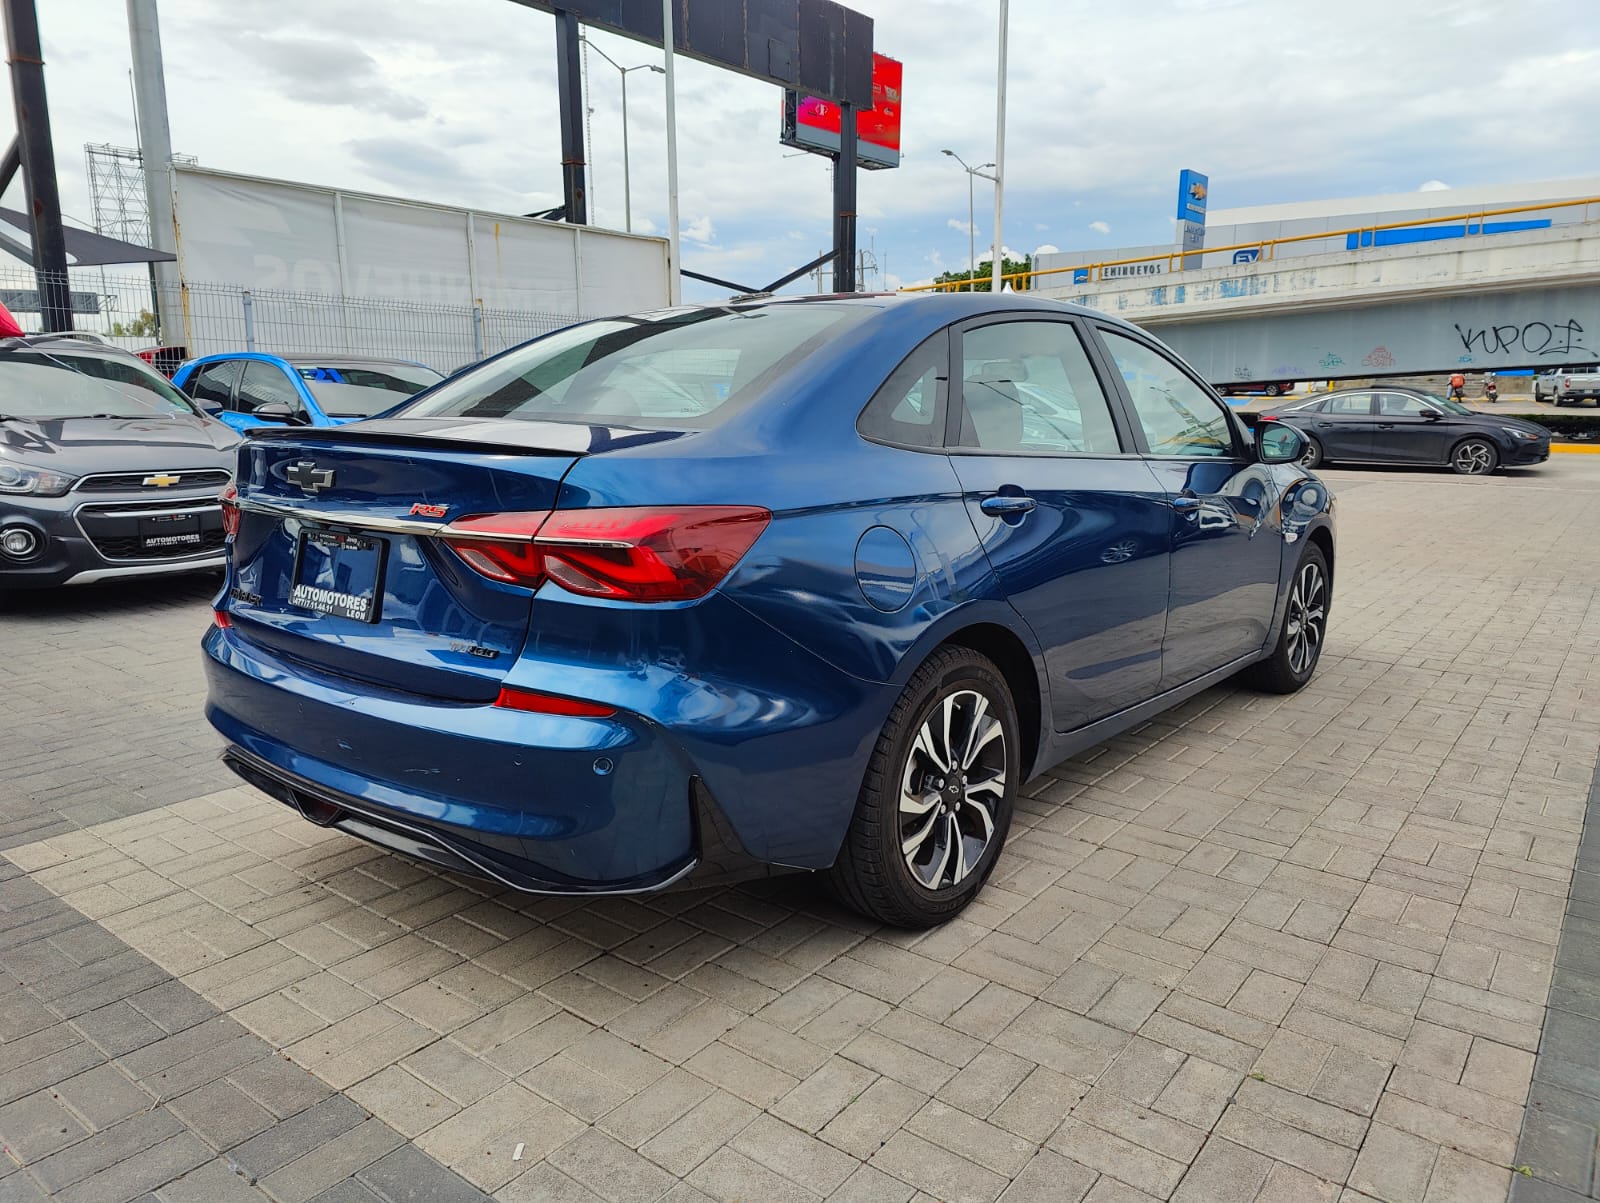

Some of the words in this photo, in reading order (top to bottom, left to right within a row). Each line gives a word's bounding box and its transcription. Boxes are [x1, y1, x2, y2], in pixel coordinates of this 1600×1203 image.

[1103, 264, 1161, 277] EMINUEVOS
[409, 502, 447, 518] RS
[146, 534, 200, 545] AUTOMOTORES
[293, 583, 367, 612] AUTOMOTORES
[346, 608, 366, 620] LEON
